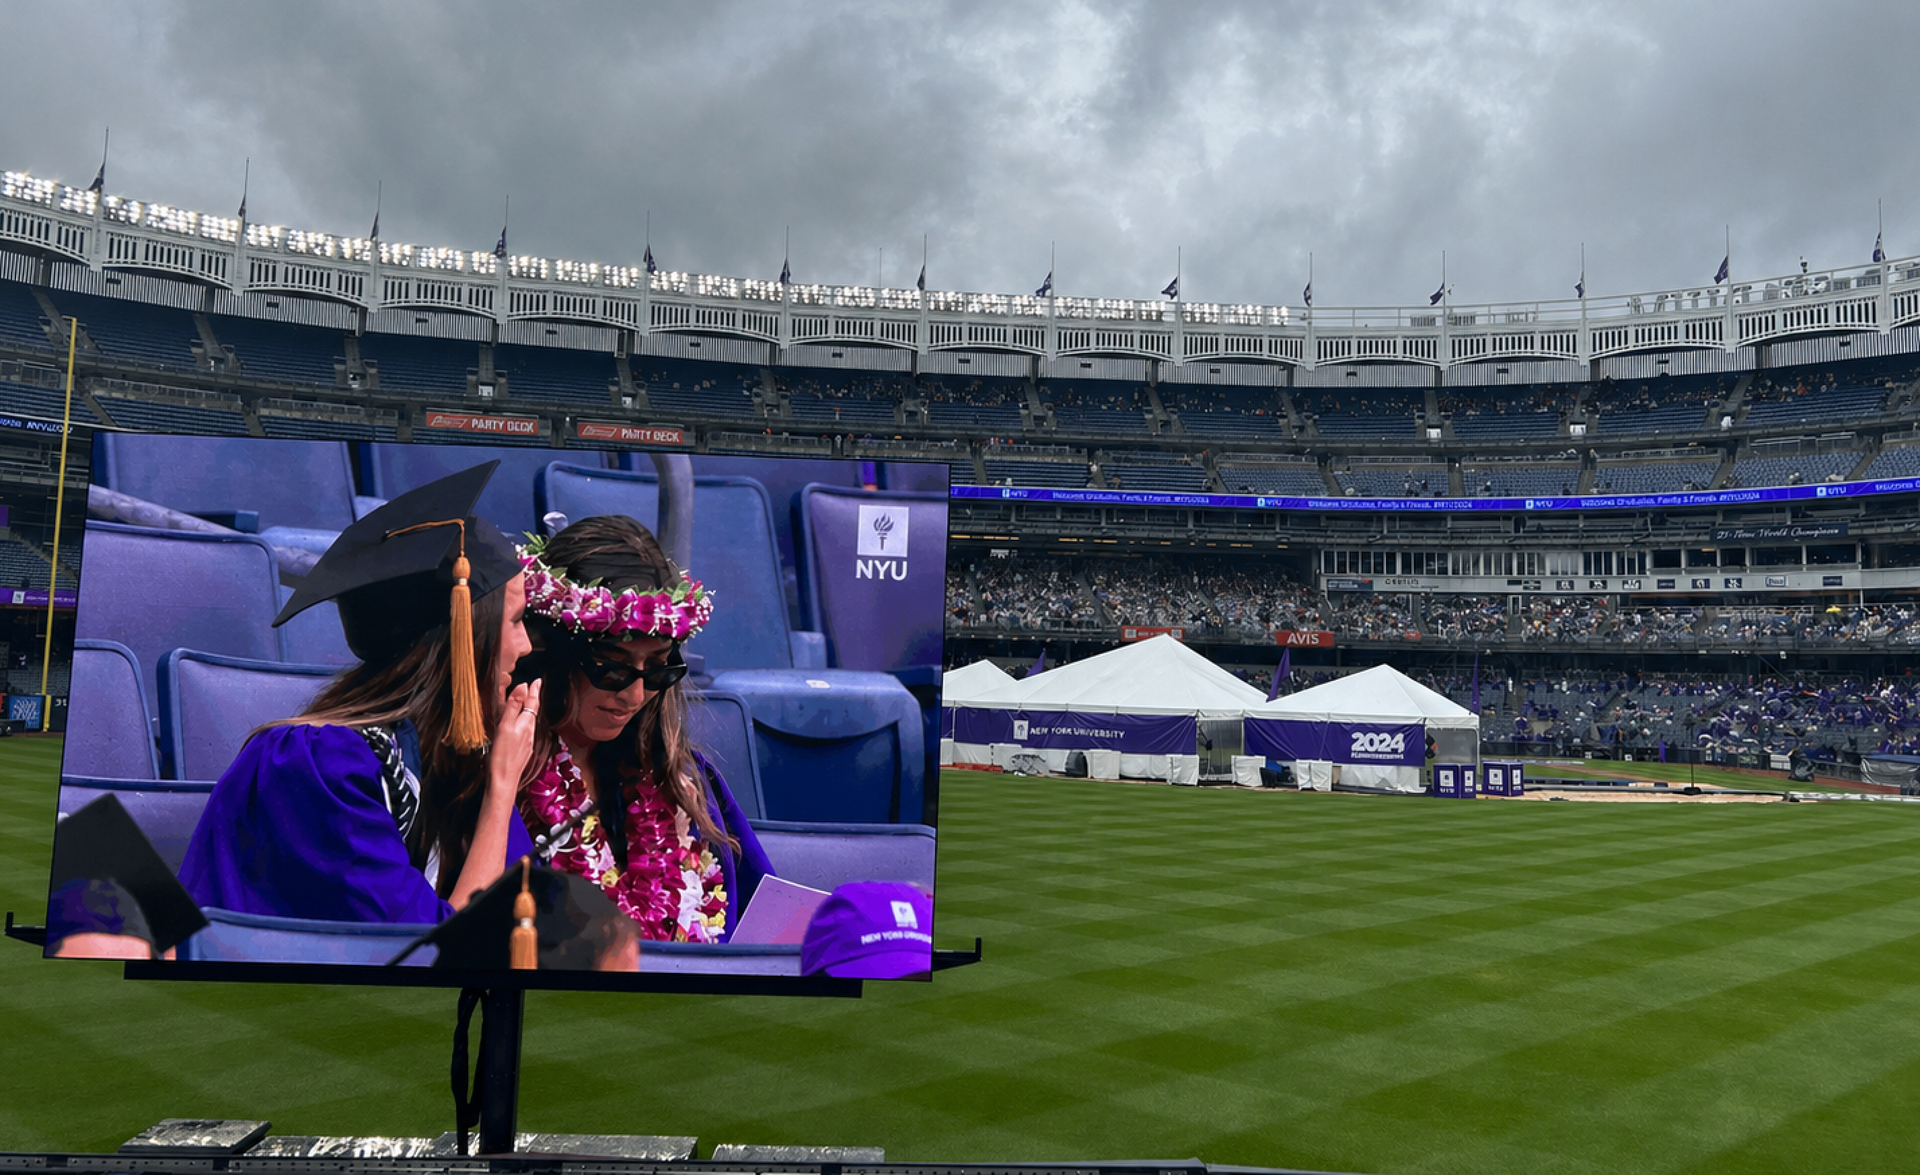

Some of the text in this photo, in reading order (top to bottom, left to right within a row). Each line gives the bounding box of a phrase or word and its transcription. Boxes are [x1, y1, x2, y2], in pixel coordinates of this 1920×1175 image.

[471, 418, 504, 430] PARTY
[507, 421, 534, 432] DECK
[621, 428, 651, 440] PARTY
[653, 431, 679, 442] DECK
[856, 559, 907, 580] NYU
[1286, 632, 1320, 645] AVIS
[1051, 727, 1072, 735] YORK
[1073, 728, 1126, 739] UNIVERSITY
[1351, 732, 1405, 753] 2024
